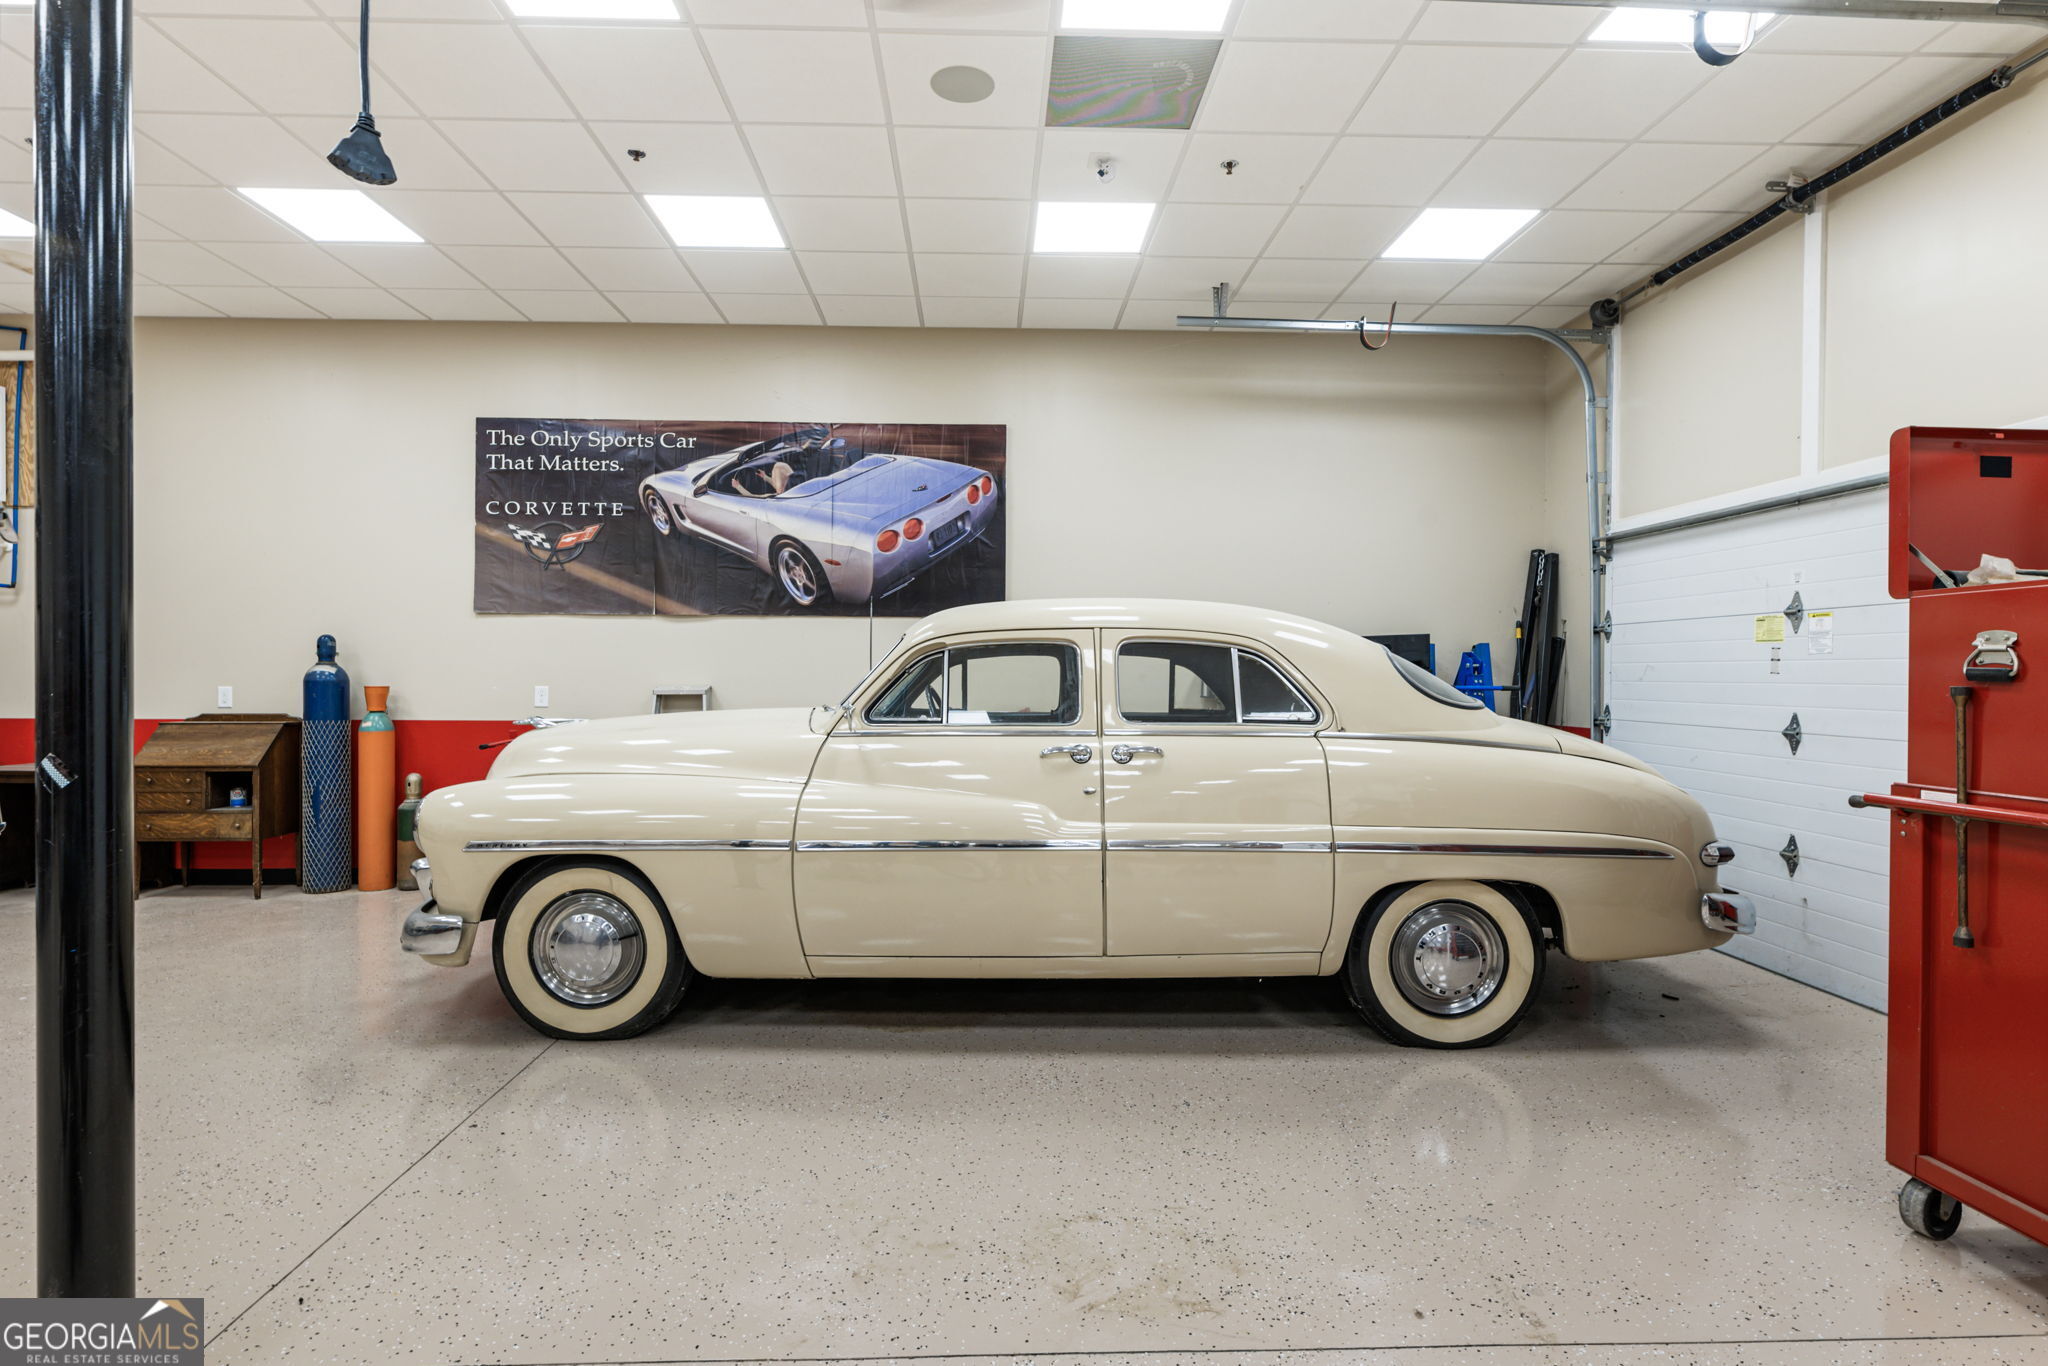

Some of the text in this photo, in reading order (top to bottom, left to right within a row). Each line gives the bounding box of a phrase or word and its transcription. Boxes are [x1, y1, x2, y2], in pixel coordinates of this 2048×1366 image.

[486, 430, 697, 452] The Only Sports Car
[486, 453, 624, 471] That Matters.
[485, 500, 624, 517] CORVETTE
